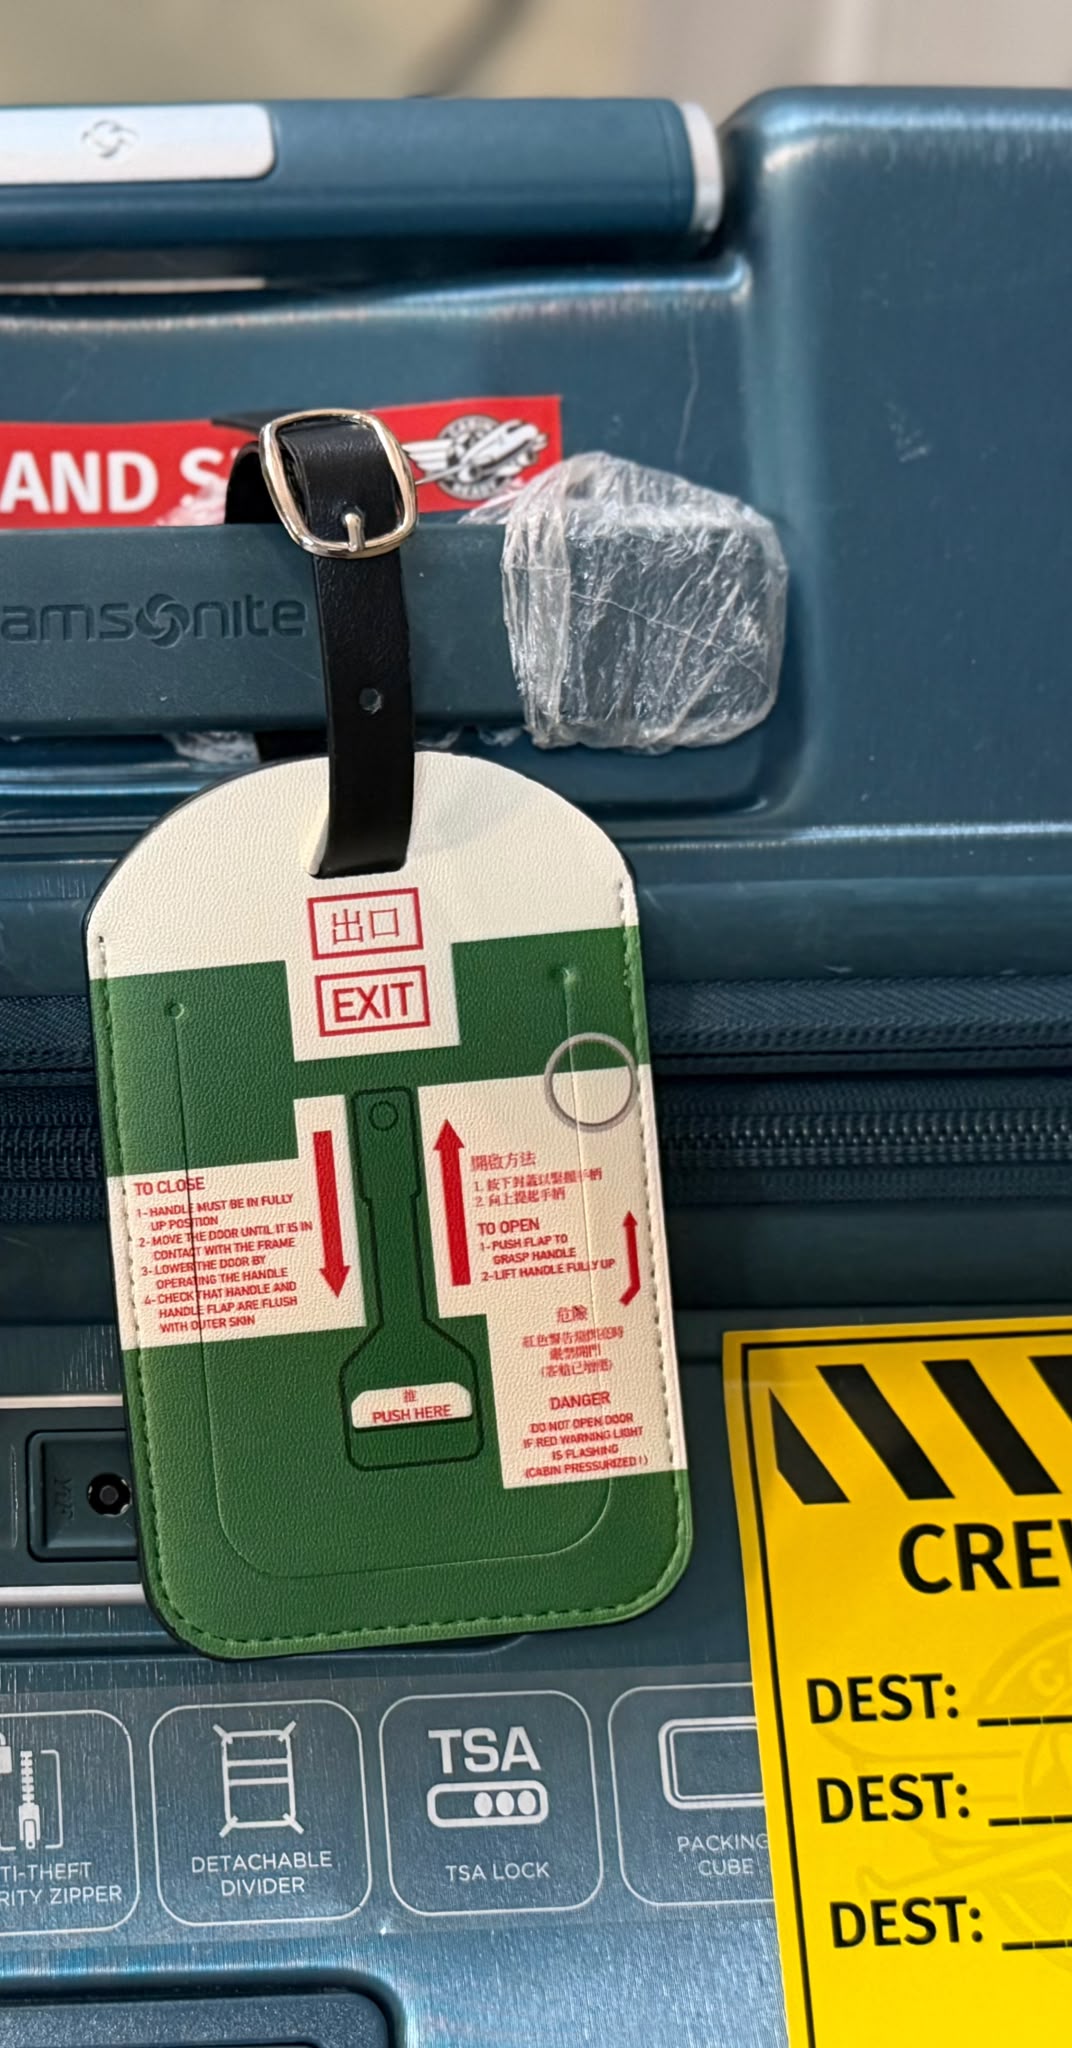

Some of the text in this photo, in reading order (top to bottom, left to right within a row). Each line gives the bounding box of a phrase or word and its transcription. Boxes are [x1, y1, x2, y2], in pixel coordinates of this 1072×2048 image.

[0, 451, 158, 513] AND
[332, 908, 399, 944] 出口
[332, 982, 414, 1023] EXIT
[135, 1177, 205, 1195] TO CLOSE
[150, 1203, 194, 1217] HANDLE
[197, 1200, 226, 1212] MUST
[230, 1199, 244, 1209] BE
[247, 1197, 259, 1207] IN
[262, 1194, 293, 1206] FULLY
[151, 1221, 167, 1231] UP
[152, 1234, 182, 1246] MOVE
[186, 1230, 206, 1242] THE
[209, 1228, 238, 1240] DOOR
[241, 1224, 273, 1237] UNTIL
[276, 1223, 286, 1233] IT
[288, 1222, 298, 1232] IS
[301, 1221, 313, 1231] IN
[478, 1217, 540, 1236] TO OPEN
[154, 1238, 295, 1261] CONTACT WITH THE FRAME
[524, 1236, 552, 1248] FLAP
[555, 1233, 568, 1244] TO
[155, 1262, 195, 1275] LOWER
[196, 1260, 217, 1271] THE
[220, 1257, 250, 1269] DOOR
[252, 1255, 266, 1266] BY
[493, 1248, 576, 1265] GRASP HANDLE
[519, 1263, 564, 1277] HANDLE
[567, 1260, 599, 1273] FULLY
[601, 1259, 616, 1269] UP
[156, 1267, 288, 1290] OPERATING THE HANDLE
[158, 1290, 194, 1304] CHECK
[196, 1288, 224, 1300] THAT
[226, 1284, 270, 1297] HANDLE
[273, 1281, 297, 1292] AND
[159, 1296, 298, 1318] HANDLE FLAP ARE FLUSH
[558, 1305, 587, 1323] 危險
[160, 1315, 255, 1333] WITH OUTER SKIN
[550, 1391, 610, 1410] DANGER
[373, 1405, 452, 1423] PUSH HERE
[531, 1413, 633, 1433] DO NOT OPEN DOOR
[523, 1427, 643, 1448] IF RED WARNING LIGHT
[552, 1444, 619, 1460] IS FLASHING
[525, 1464, 561, 1479] (CABIN
[899, 1519, 1072, 1595] CRE
[805, 1673, 960, 1725] DEST:
[428, 1726, 541, 1774] TSA
[816, 1772, 970, 1825] DEST:
[677, 1834, 770, 1853] PACKING
[191, 1851, 332, 1873] DETACHABLE
[445, 1861, 550, 1882] TSA LOCK
[698, 1858, 754, 1877] CUBE
[50, 1885, 122, 1904] ZIPPER
[221, 1877, 305, 1897] DIVIDER
[828, 1896, 984, 1950] DEST:
